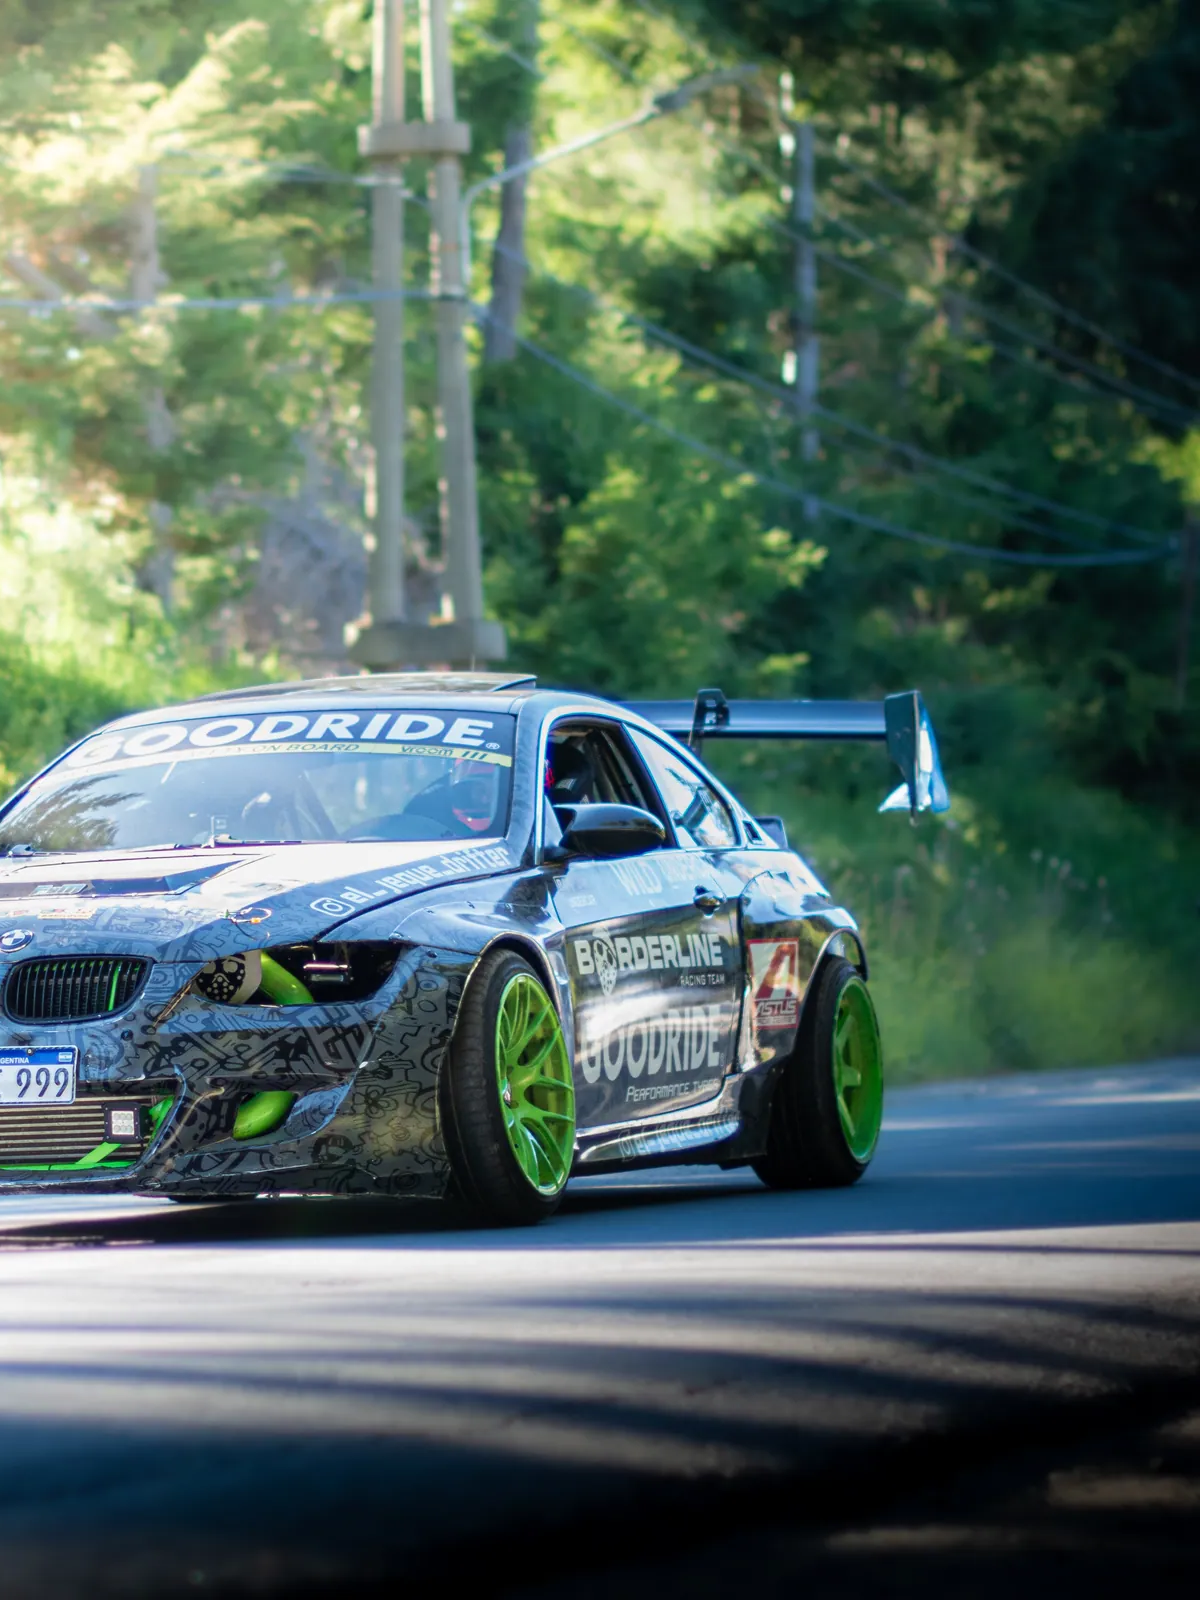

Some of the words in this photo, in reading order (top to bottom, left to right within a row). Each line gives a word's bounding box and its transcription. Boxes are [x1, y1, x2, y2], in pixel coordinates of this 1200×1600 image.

[286, 743, 360, 752] BOARD
[680, 974, 706, 986] RACING
[707, 973, 726, 985] TEAM
[579, 1003, 721, 1084] GOODRIDE
[16, 1067, 70, 1099] 999
